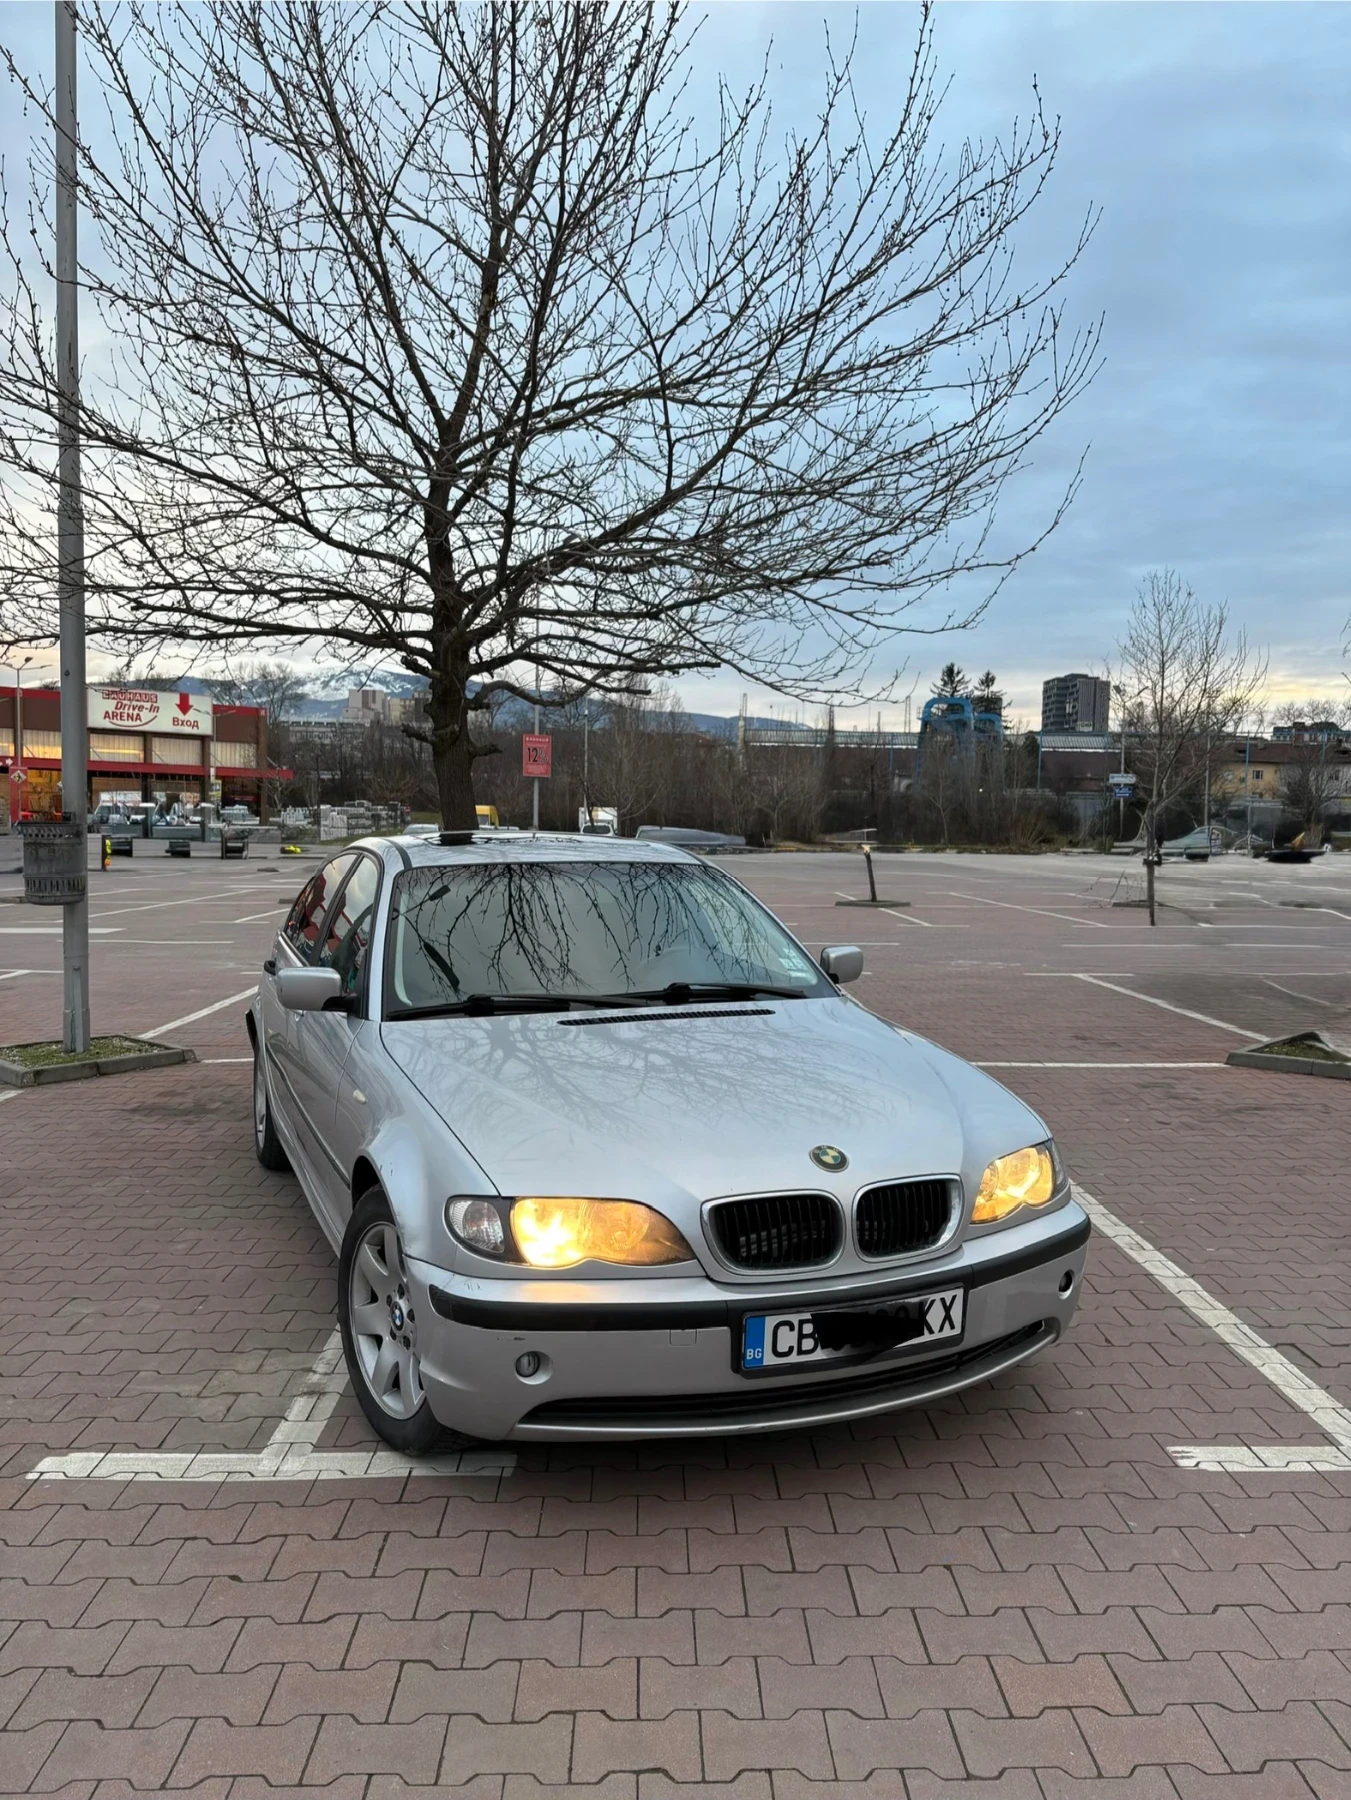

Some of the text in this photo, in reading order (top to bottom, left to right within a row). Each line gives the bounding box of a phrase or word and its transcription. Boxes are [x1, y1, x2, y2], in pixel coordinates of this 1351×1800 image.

[114, 701, 160, 714] Drive-In
[103, 711, 142, 723] ARENA
[172, 717, 199, 729] Вход
[746, 1348, 762, 1360] BG
